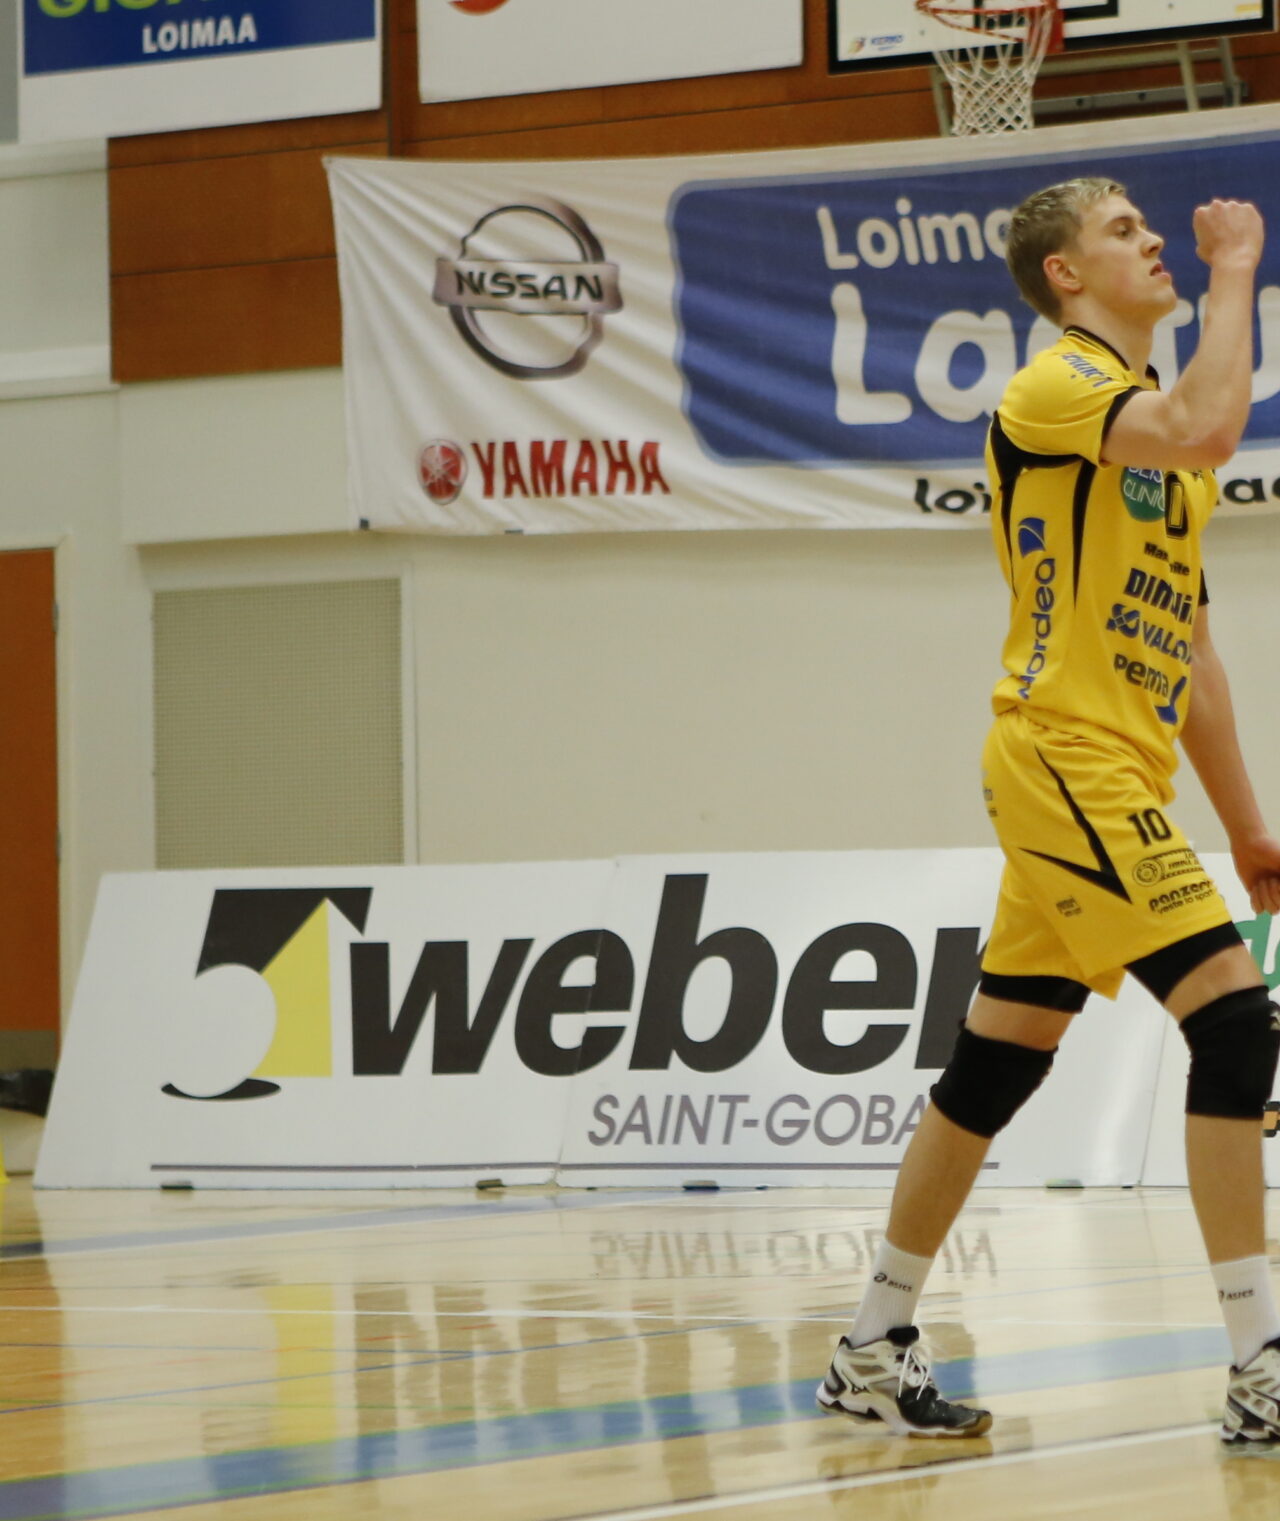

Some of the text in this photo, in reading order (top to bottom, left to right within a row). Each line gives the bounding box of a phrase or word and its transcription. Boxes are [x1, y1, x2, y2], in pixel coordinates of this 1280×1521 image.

[142, 14, 257, 54] LOIMAA
[454, 270, 603, 301] NISSAN
[471, 439, 672, 500] YAMAHA
[1016, 556, 1056, 701] Nordea
[1127, 807, 1172, 848] 10
[349, 873, 988, 1077] weber
